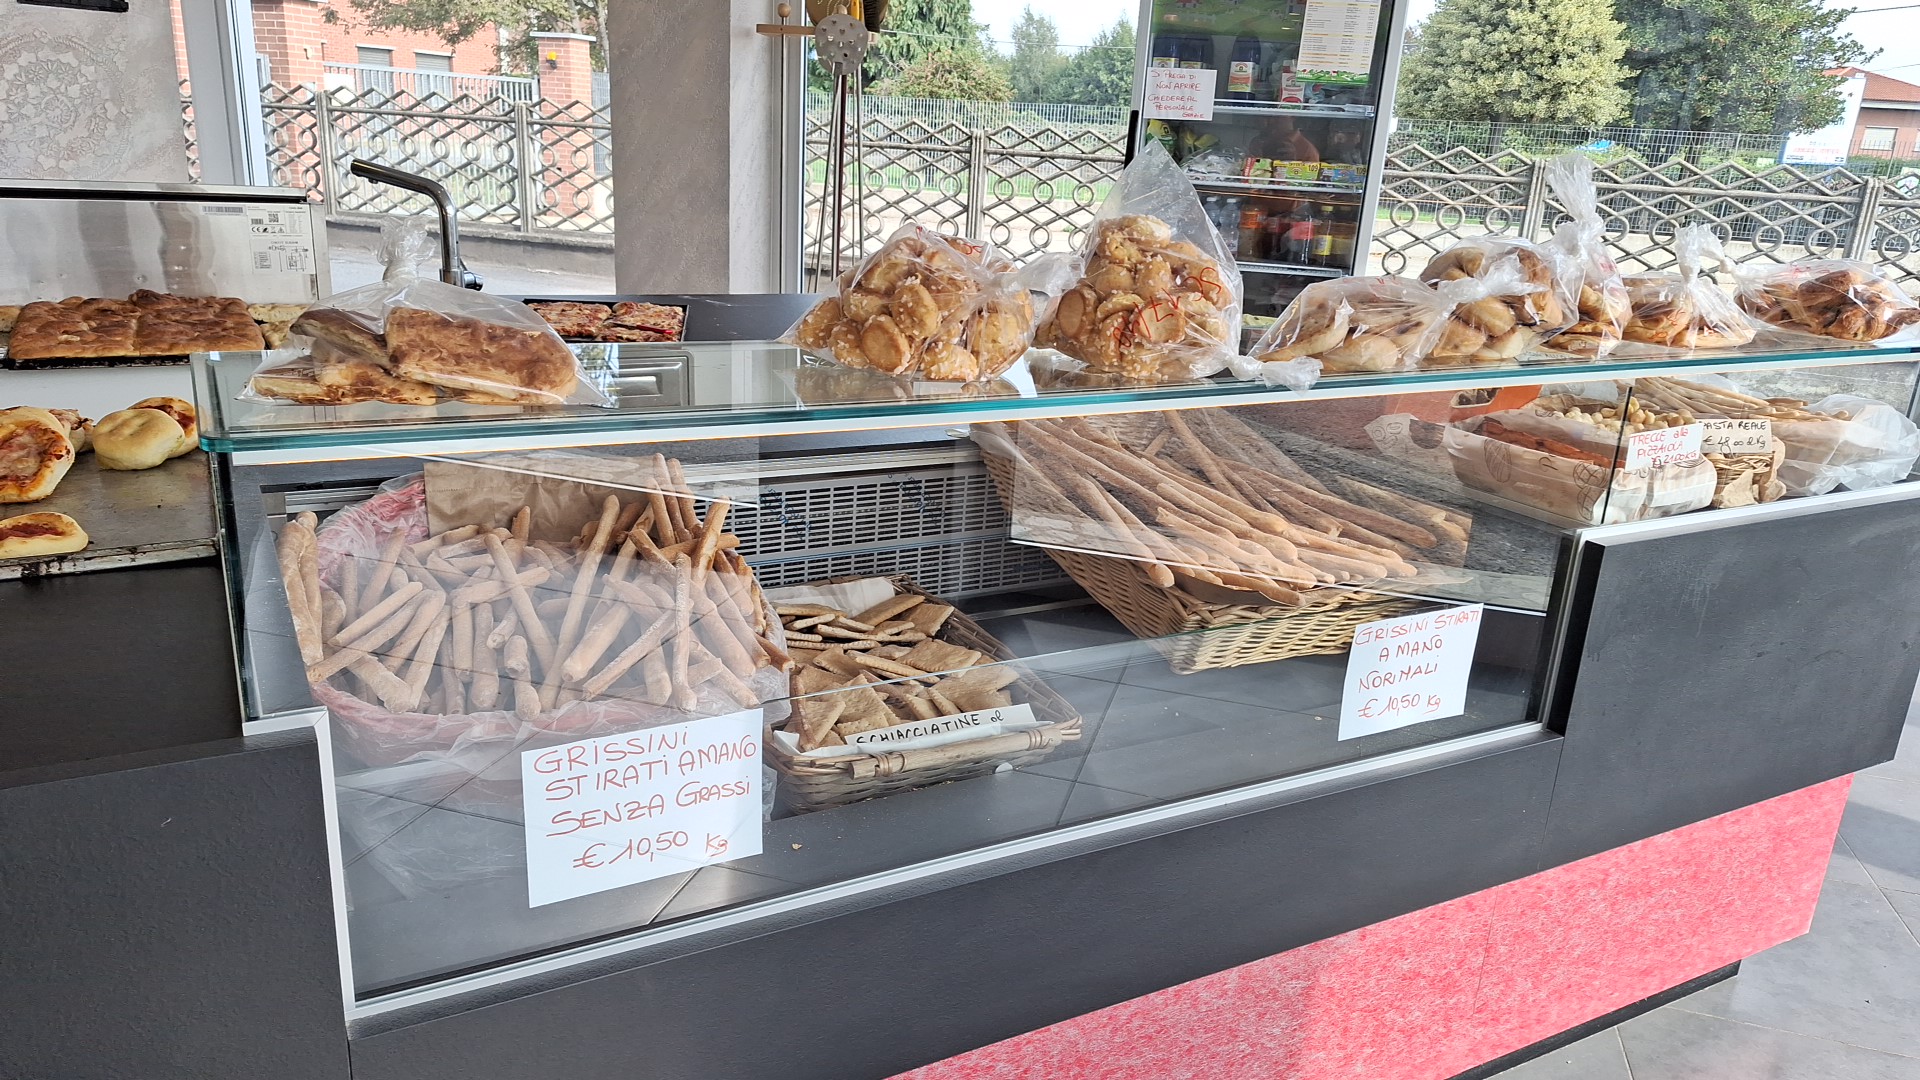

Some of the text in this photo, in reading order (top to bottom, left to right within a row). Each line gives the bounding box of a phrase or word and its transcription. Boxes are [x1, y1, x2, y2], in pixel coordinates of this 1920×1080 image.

[1156, 80, 1202, 91] NON APRIRE
[1163, 69, 1186, 79] PREGA
[1147, 94, 1185, 102] CHIEDERE
[1152, 102, 1194, 111] PERSONALE
[1738, 420, 1767, 430] REALE
[1637, 440, 1683, 459] PIZZAIOLA
[1355, 607, 1480, 645] GRISSINI STIRATI
[1379, 634, 1443, 662] A MANO
[1358, 655, 1440, 693] NORMALI
[1358, 698, 1379, 719] €
[1378, 693, 1421, 716] 10,50
[533, 726, 689, 774] GRISSINI
[545, 754, 669, 801] STIRATI
[546, 775, 751, 837] SENZA GRASSI
[573, 843, 607, 869] €
[608, 831, 689, 865] 10,50
